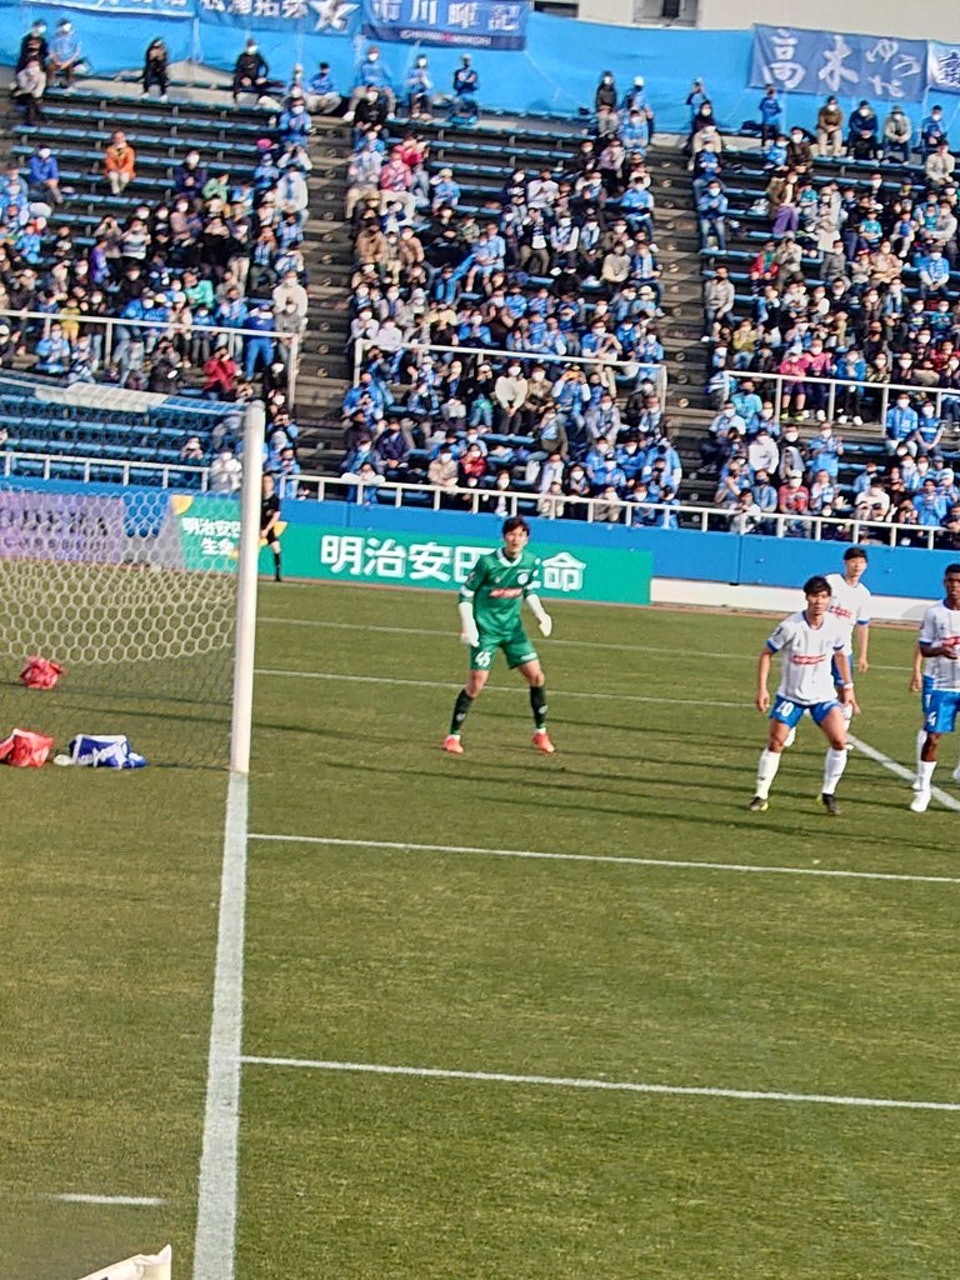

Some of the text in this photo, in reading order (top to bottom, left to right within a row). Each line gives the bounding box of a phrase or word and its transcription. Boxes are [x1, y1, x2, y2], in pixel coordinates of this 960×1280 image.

[320, 534, 587, 592] 明治安田命
